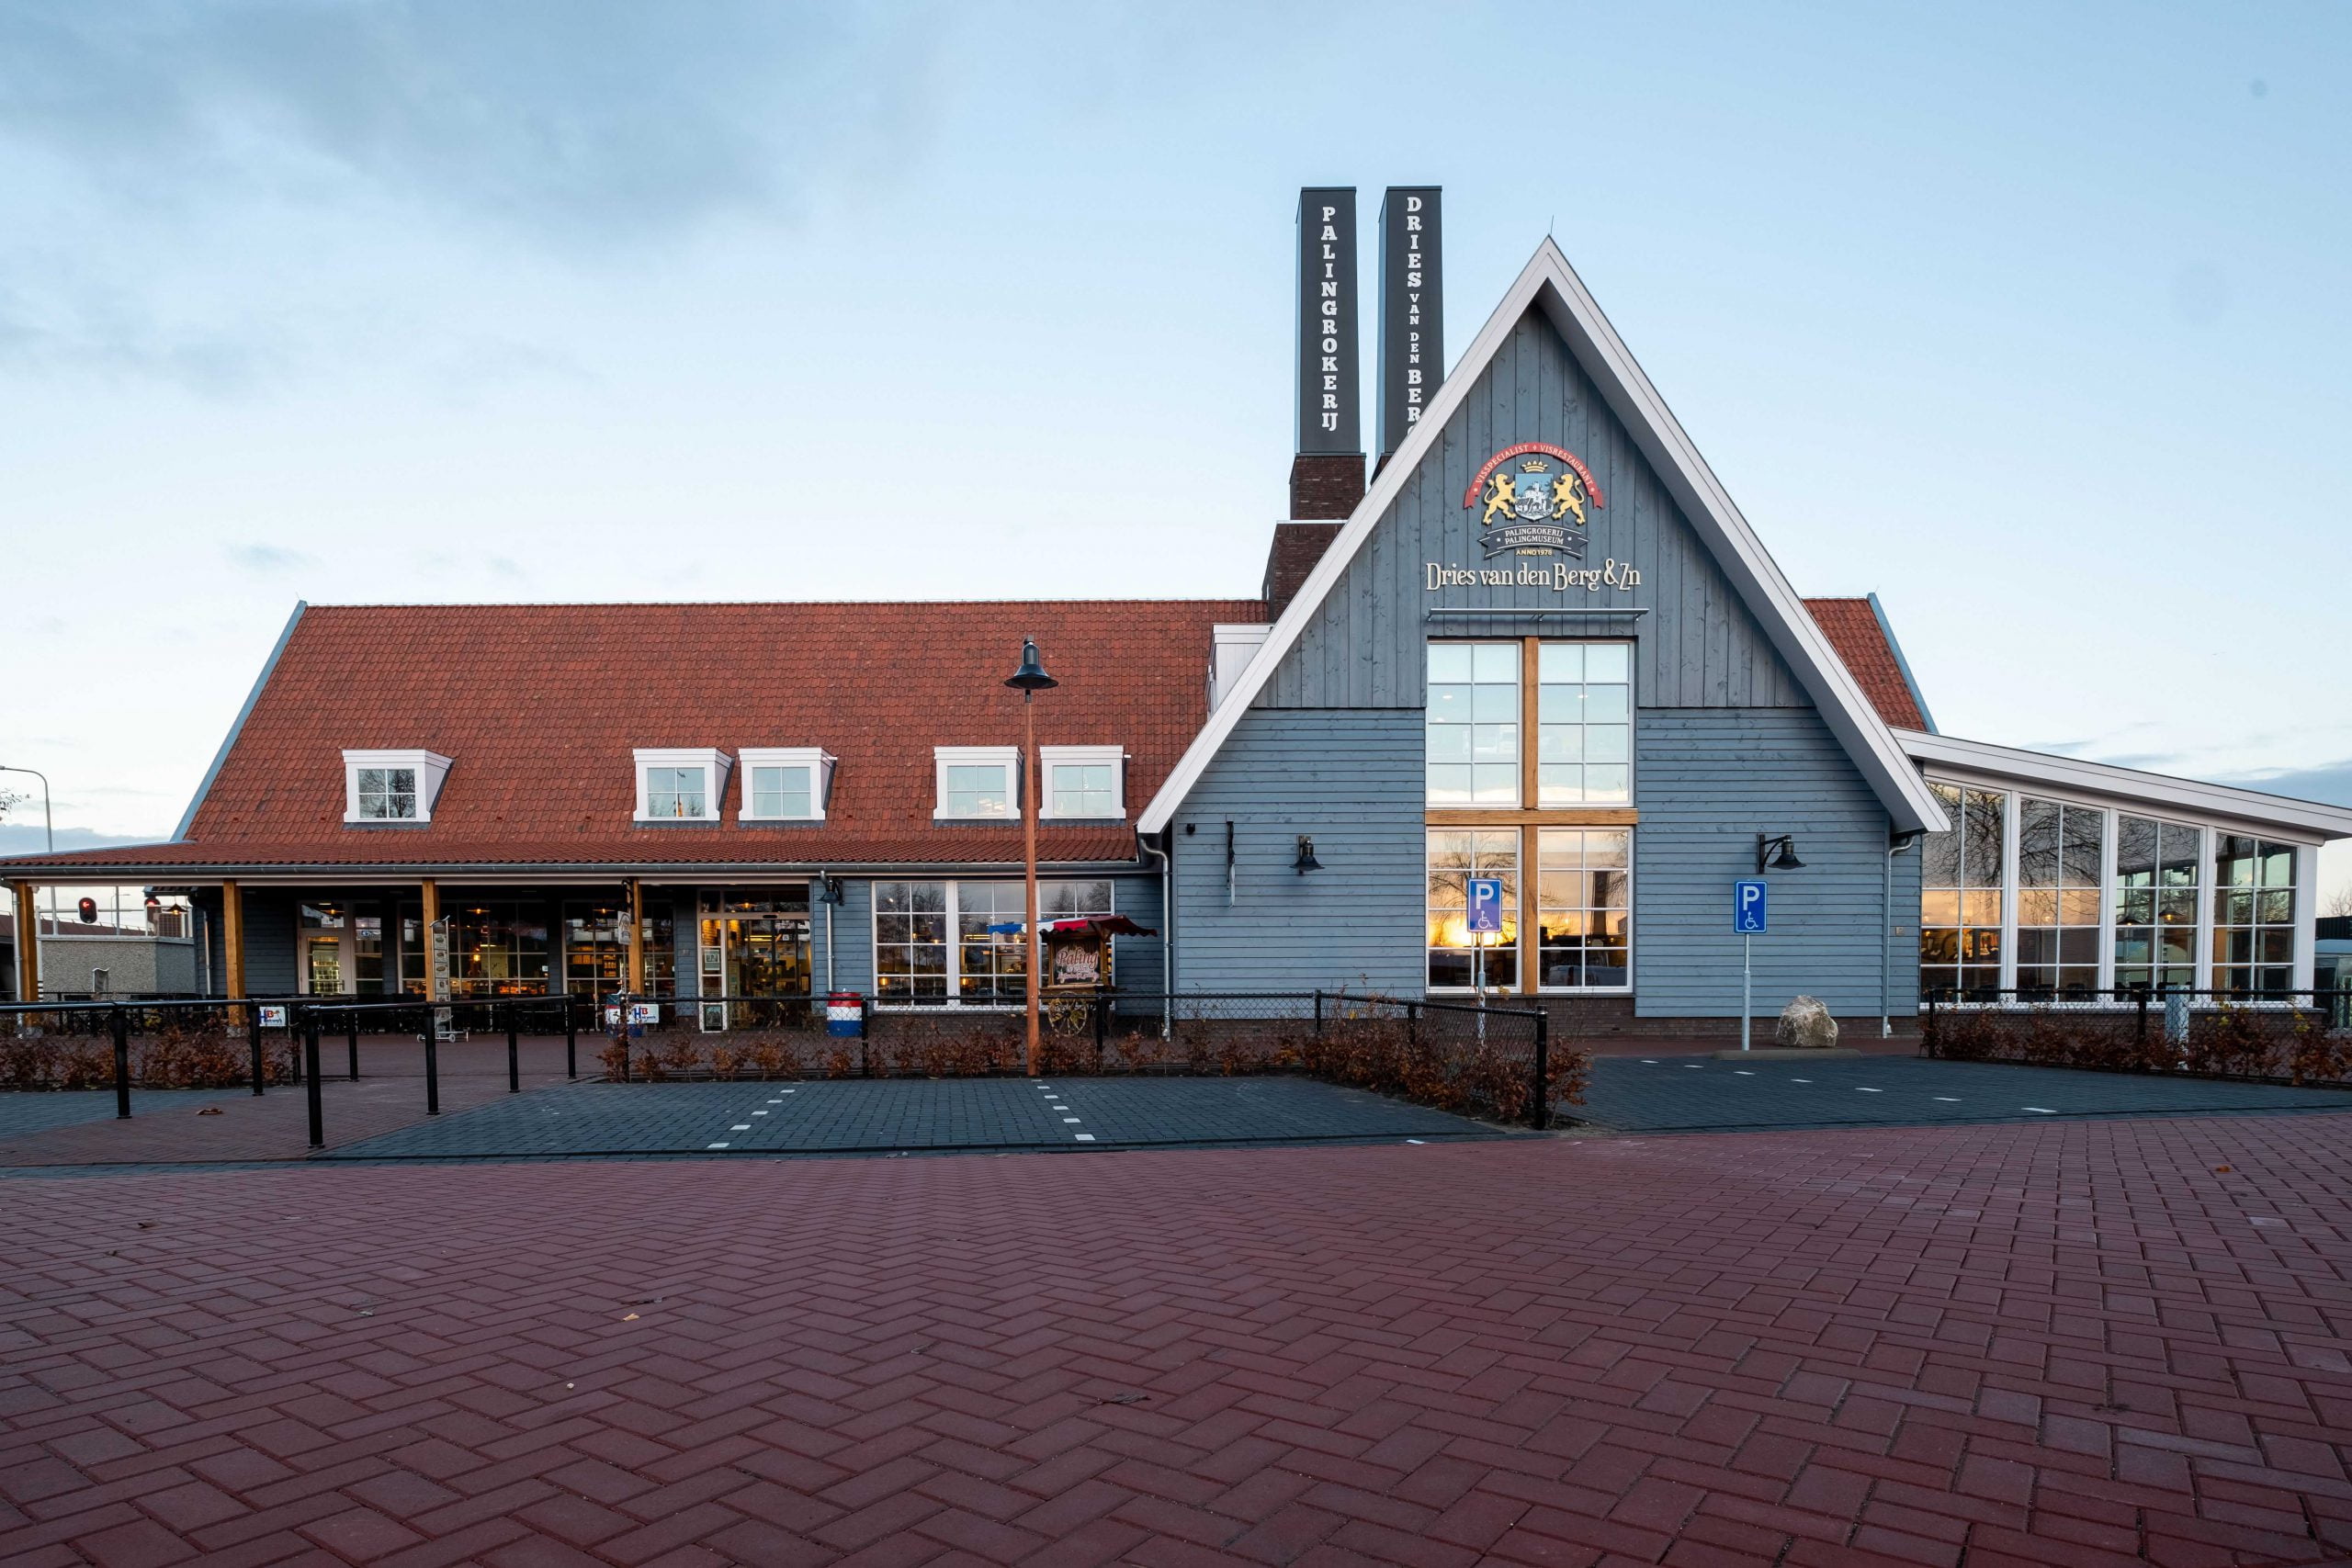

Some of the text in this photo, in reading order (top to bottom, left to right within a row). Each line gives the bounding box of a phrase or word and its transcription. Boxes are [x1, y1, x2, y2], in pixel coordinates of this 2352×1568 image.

[1408, 197, 1422, 288] DRIES
[1321, 207, 1338, 431] PALINGROKERIJ
[1409, 293, 1420, 325] VAN
[1409, 333, 1419, 364] DEN
[1476, 445, 1594, 485] VISSPECIALIST VISRESTAURANT
[1505, 527, 1564, 537] PALINGROKERIJ
[1505, 536, 1564, 545] PALINGMUSEUM
[1426, 562, 1476, 591] Dries
[1479, 570, 1514, 585] van
[1517, 562, 1551, 585] den
[1553, 563, 1601, 591] Berg
[1476, 883, 1495, 909] P
[1743, 886, 1760, 911] P
[1057, 947, 1098, 970] Paling
